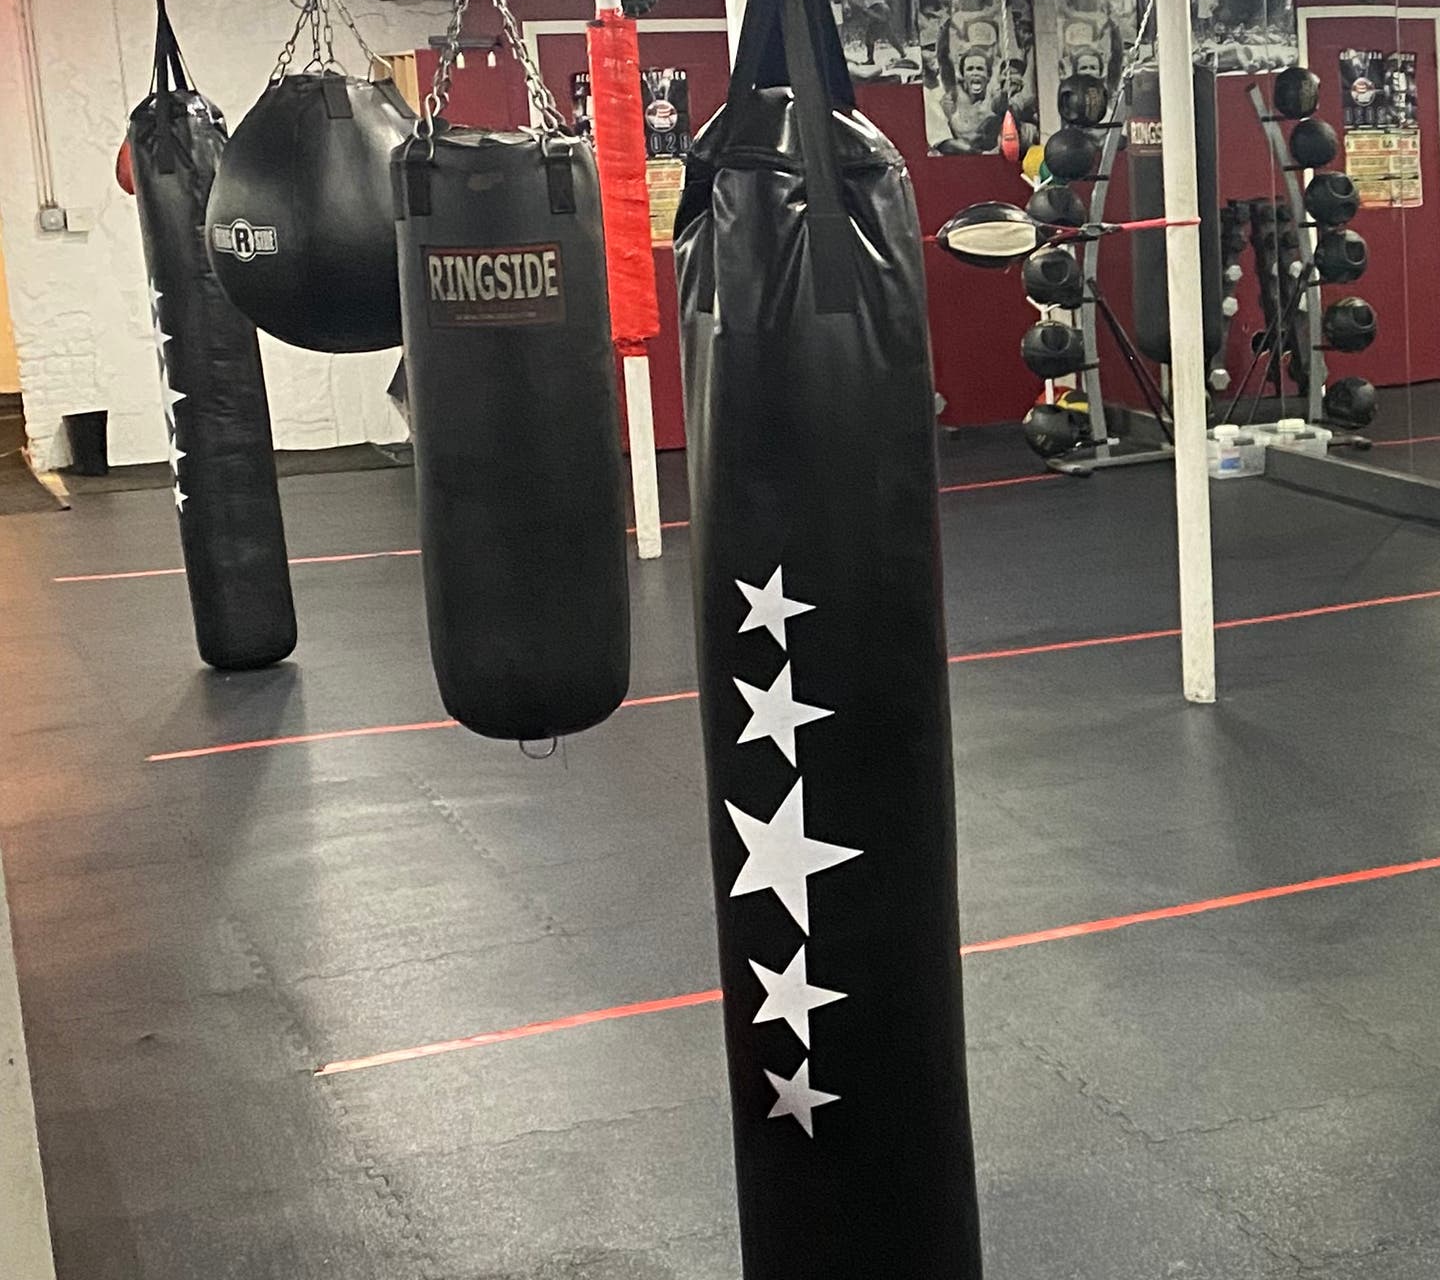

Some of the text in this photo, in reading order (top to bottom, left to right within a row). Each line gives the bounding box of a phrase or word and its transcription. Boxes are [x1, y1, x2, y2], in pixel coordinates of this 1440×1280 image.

[1130, 121, 1162, 145] RINGS
[234, 227, 252, 253] R
[428, 250, 559, 301] RINGSIDE
